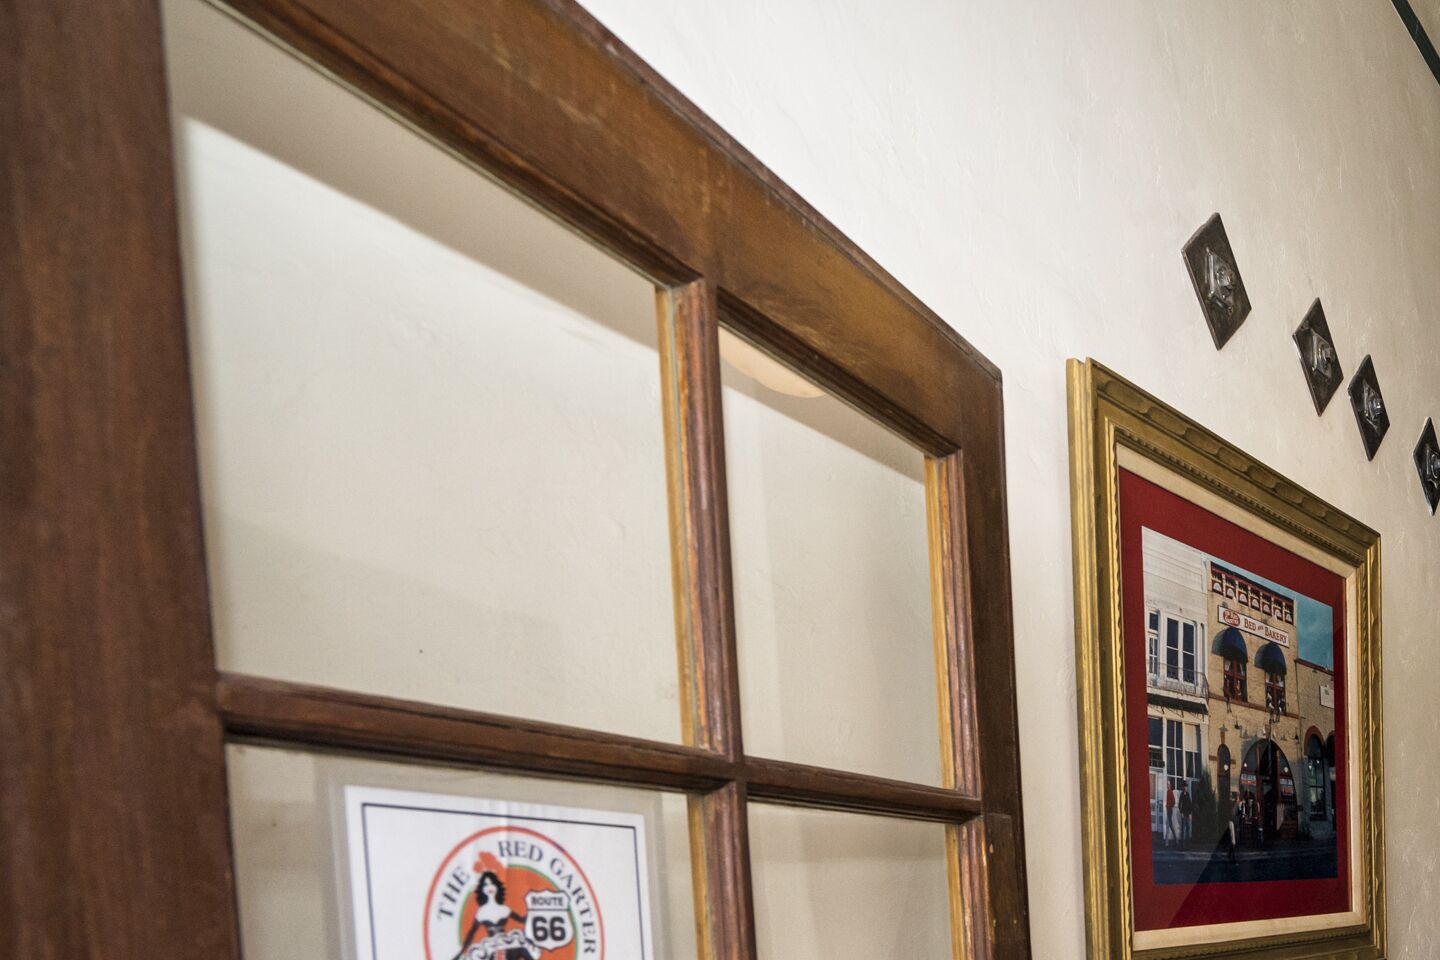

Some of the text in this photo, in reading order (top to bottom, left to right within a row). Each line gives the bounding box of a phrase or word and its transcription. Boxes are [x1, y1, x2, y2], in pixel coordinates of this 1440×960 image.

[1244, 618, 1257, 631] BED
[1264, 626, 1287, 643] BAKERY
[437, 840, 597, 954] THE RED GARTER
[531, 896, 564, 906] ROUTE
[532, 916, 566, 942] 66
